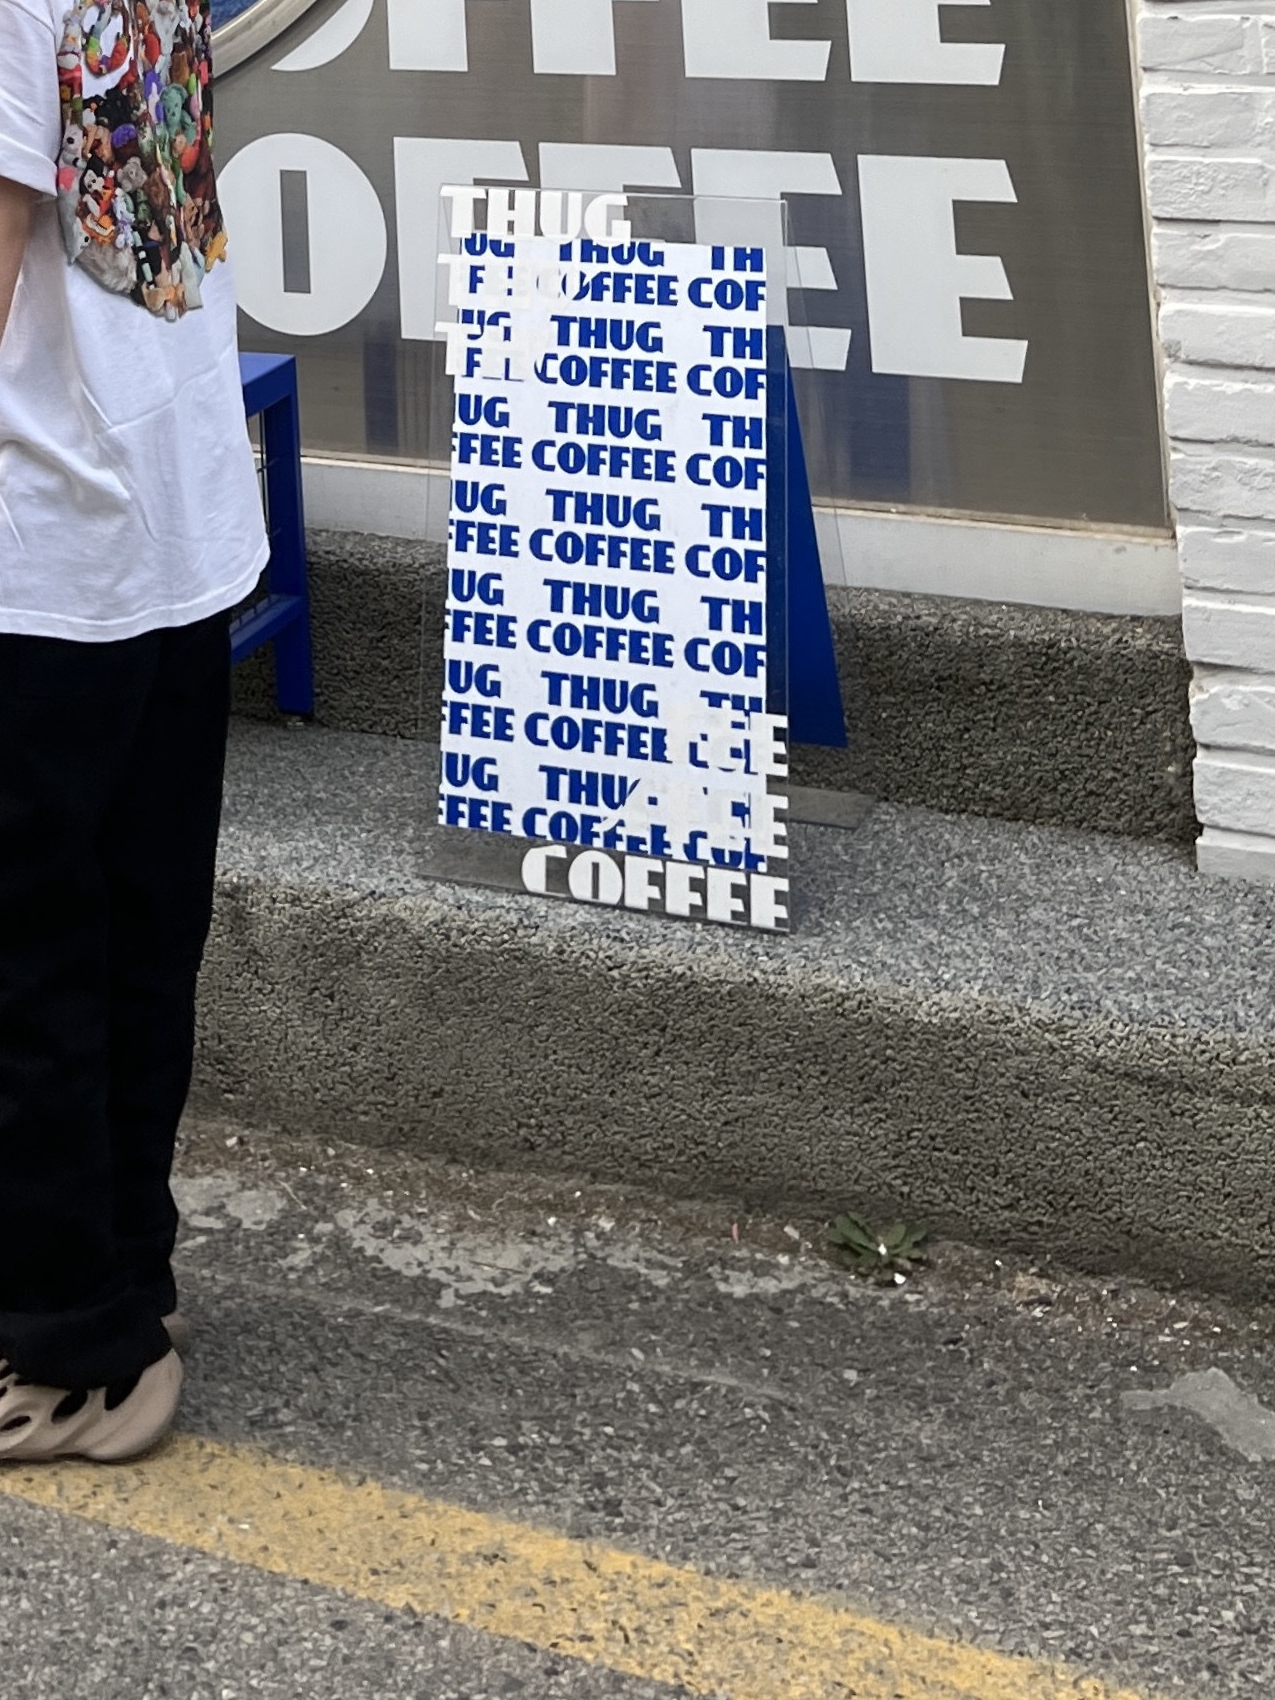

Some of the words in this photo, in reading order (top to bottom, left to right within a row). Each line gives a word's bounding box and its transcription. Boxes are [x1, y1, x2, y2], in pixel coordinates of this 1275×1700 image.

[439, 184, 632, 244] THUG
[550, 314, 664, 354] THUG
[703, 325, 764, 361] TH
[534, 352, 677, 394] COFFEE
[687, 363, 766, 400] COF
[455, 393, 510, 429] UG
[548, 400, 662, 442] THUG
[702, 412, 764, 450] TH
[451, 431, 523, 469] FEE
[531, 439, 676, 484] COFFEE
[686, 452, 766, 491] COF
[452, 479, 507, 516] UG
[546, 488, 661, 532] THUG
[702, 503, 764, 542] TH
[449, 519, 520, 558] FEE
[528, 528, 675, 575] COFFEE
[685, 544, 766, 584] COF
[449, 567, 505, 606] UG
[543, 578, 660, 624] THUG
[700, 595, 764, 636] TH
[444, 608, 518, 650] FEE
[526, 618, 674, 669] COFFEE
[684, 637, 766, 679] COF
[447, 659, 502, 698] UG
[540, 670, 659, 719] THUG
[441, 700, 515, 743] FEE
[438, 793, 512, 835] FEE
[521, 844, 790, 934] COFFEE
